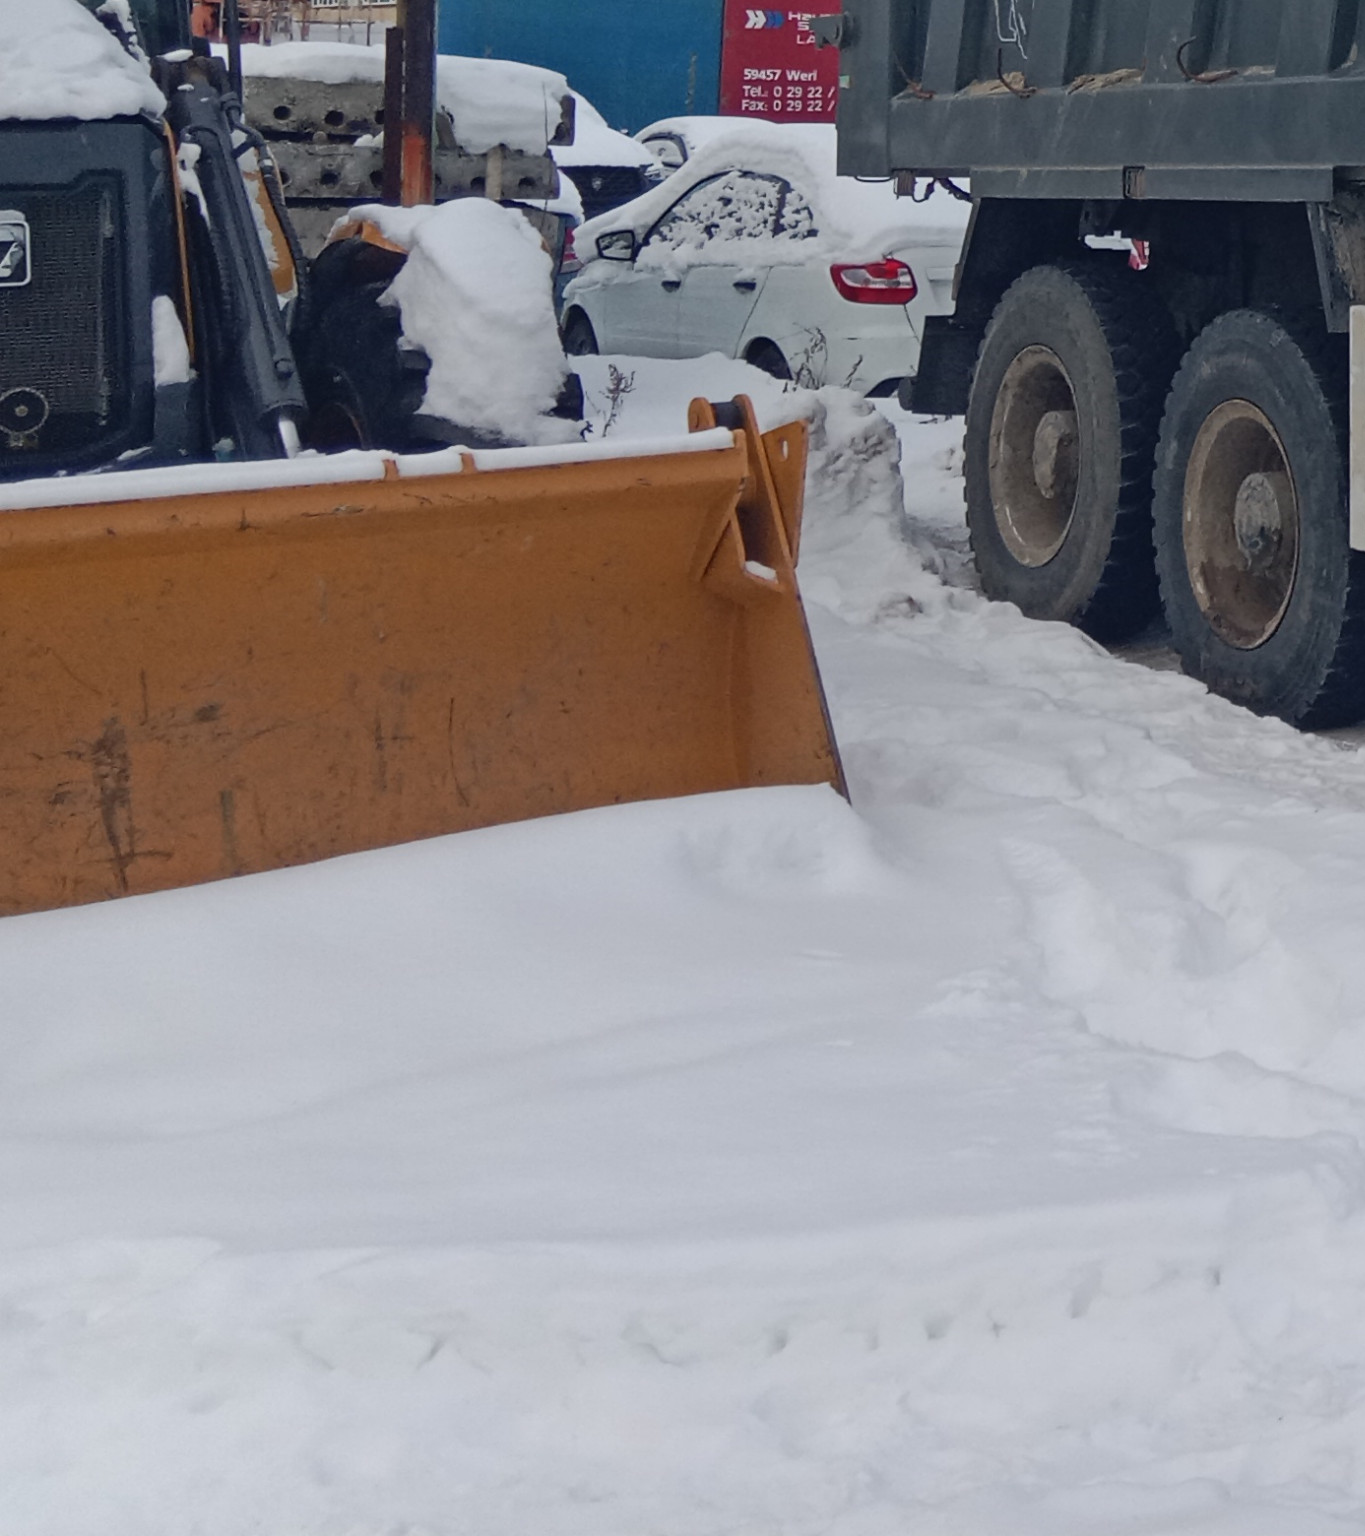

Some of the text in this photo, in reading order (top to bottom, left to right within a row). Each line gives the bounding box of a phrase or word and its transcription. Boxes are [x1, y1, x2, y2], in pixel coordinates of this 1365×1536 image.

[743, 68, 782, 81] 59457
[773, 86, 782, 98] 0
[786, 86, 803, 98] 29
[806, 86, 823, 98] 22
[773, 100, 782, 112] 0
[786, 100, 803, 112] 29
[806, 100, 823, 112] 22
